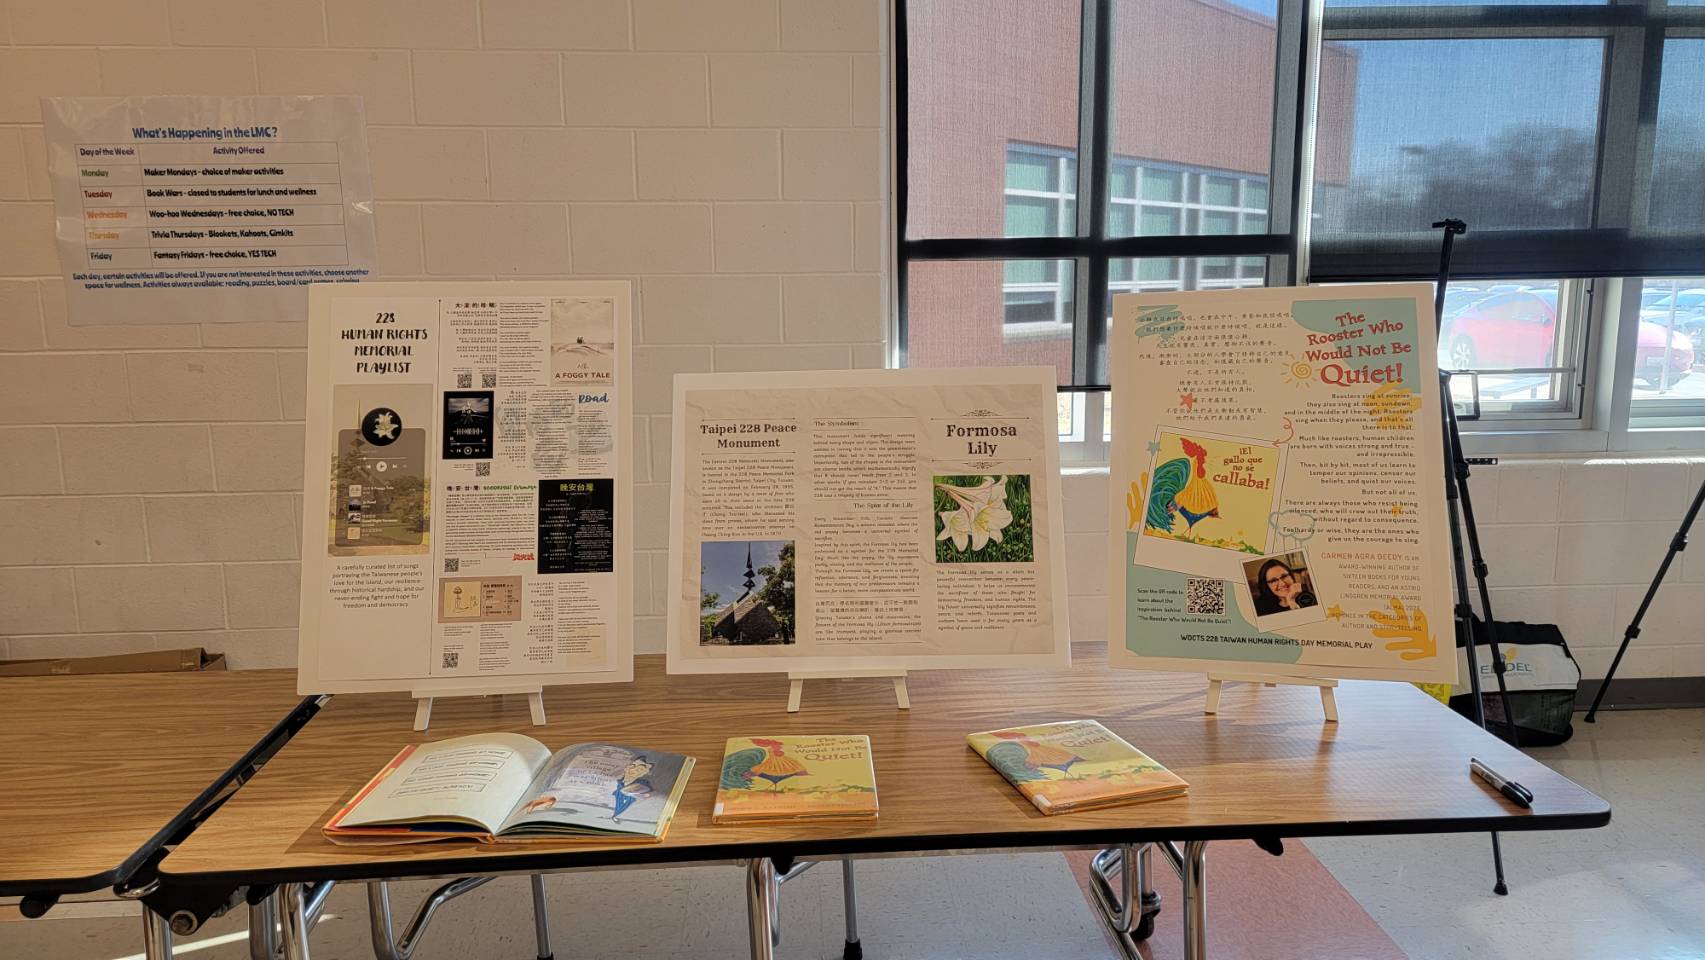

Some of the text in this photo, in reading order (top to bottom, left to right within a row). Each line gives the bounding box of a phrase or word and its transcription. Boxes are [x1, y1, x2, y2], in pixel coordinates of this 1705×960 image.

[132, 126, 278, 140] What's Happening in the LMC?
[80, 148, 94, 157] Day
[95, 148, 102, 156] of
[102, 148, 114, 156] the
[213, 146, 264, 156] Activity Offered
[82, 170, 109, 178] Monday
[144, 168, 166, 176] Maker
[167, 168, 197, 177] Mondays
[202, 168, 223, 176] choice
[84, 190, 112, 199] Tuesday
[166, 189, 183, 197] Wars
[188, 189, 209, 197] closed
[218, 188, 246, 196] students
[247, 188, 256, 196] for
[87, 211, 128, 220] Wednesday
[149, 210, 179, 218] Woo-hoo
[180, 210, 224, 219] Wednesdays
[88, 232, 119, 240] Thursday
[170, 230, 204, 239] Thursdays
[269, 229, 294, 237] Gimkits
[90, 252, 112, 262] Friday
[154, 252, 180, 260] Fantasy
[181, 251, 204, 260] Fridays
[248, 250, 260, 258] YES
[376, 312, 395, 324] 228
[1336, 312, 1366, 327] The
[341, 329, 428, 340] HUMAN RIGHTS
[1306, 320, 1404, 346] Rooster Who
[354, 345, 413, 356] MEMORIAL
[1305, 342, 1412, 362] Would Not Be
[356, 362, 412, 374] PLAYLIST
[1320, 363, 1404, 387] Quiet!
[700, 424, 797, 435] Taipei 228 Peace
[946, 425, 1017, 437] Formosa
[717, 439, 780, 448] Monument
[968, 441, 998, 457] Lily
[1223, 456, 1263, 465] gallo que
[1213, 472, 1270, 490] callaba!
[1321, 552, 1352, 560] CARMEN
[1248, 637, 1273, 645] HUMAN
[1316, 640, 1353, 648] MEMORIAL
[804, 752, 864, 761] Quiet!
